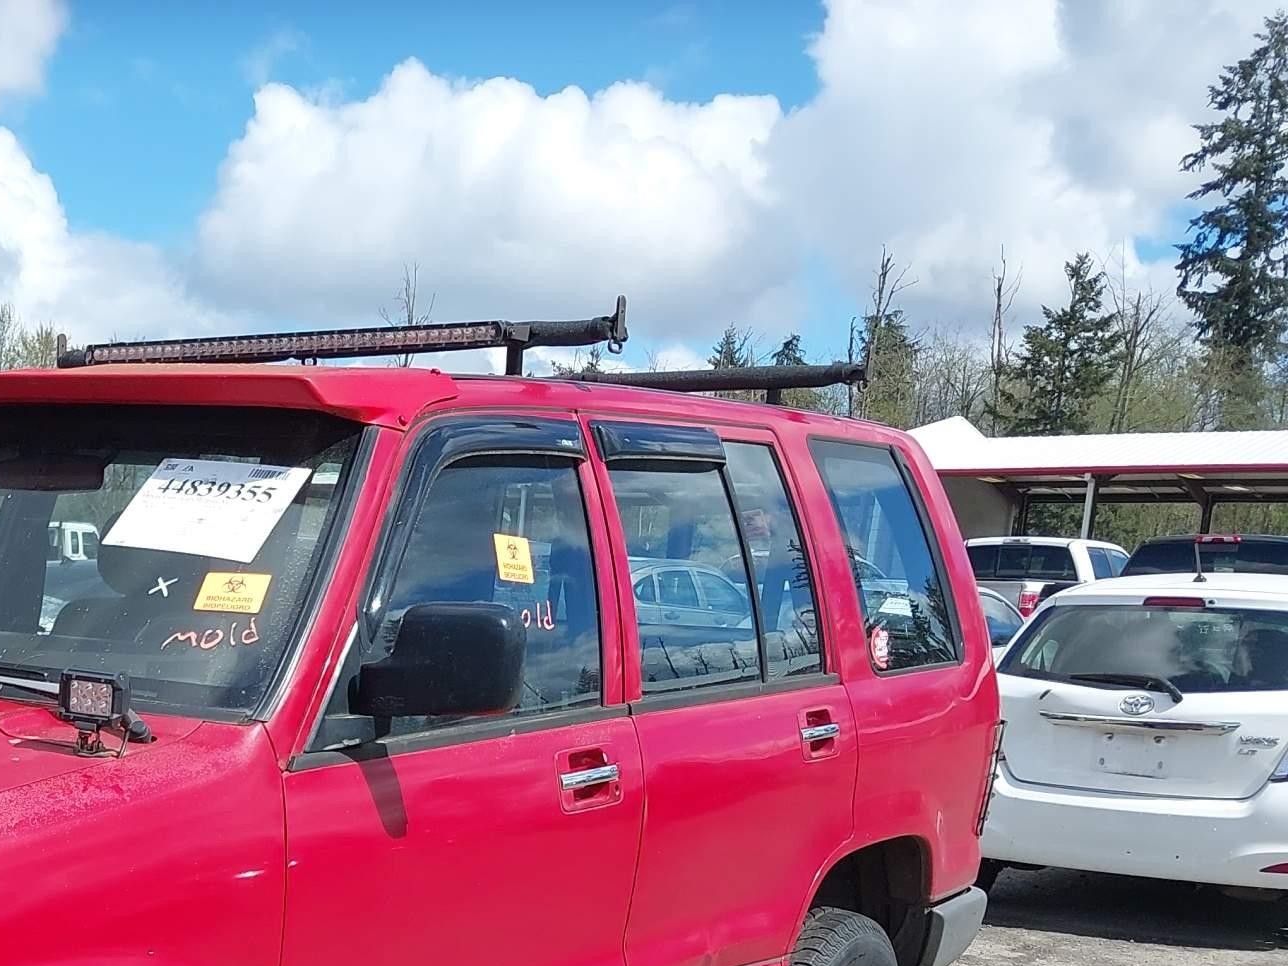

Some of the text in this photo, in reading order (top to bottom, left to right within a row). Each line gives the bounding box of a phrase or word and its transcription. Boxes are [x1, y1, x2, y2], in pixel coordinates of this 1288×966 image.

[158, 478, 277, 503] 44839355
[205, 595, 254, 604] BIOHAZARD
[520, 600, 555, 631] old
[160, 617, 260, 650] mold
